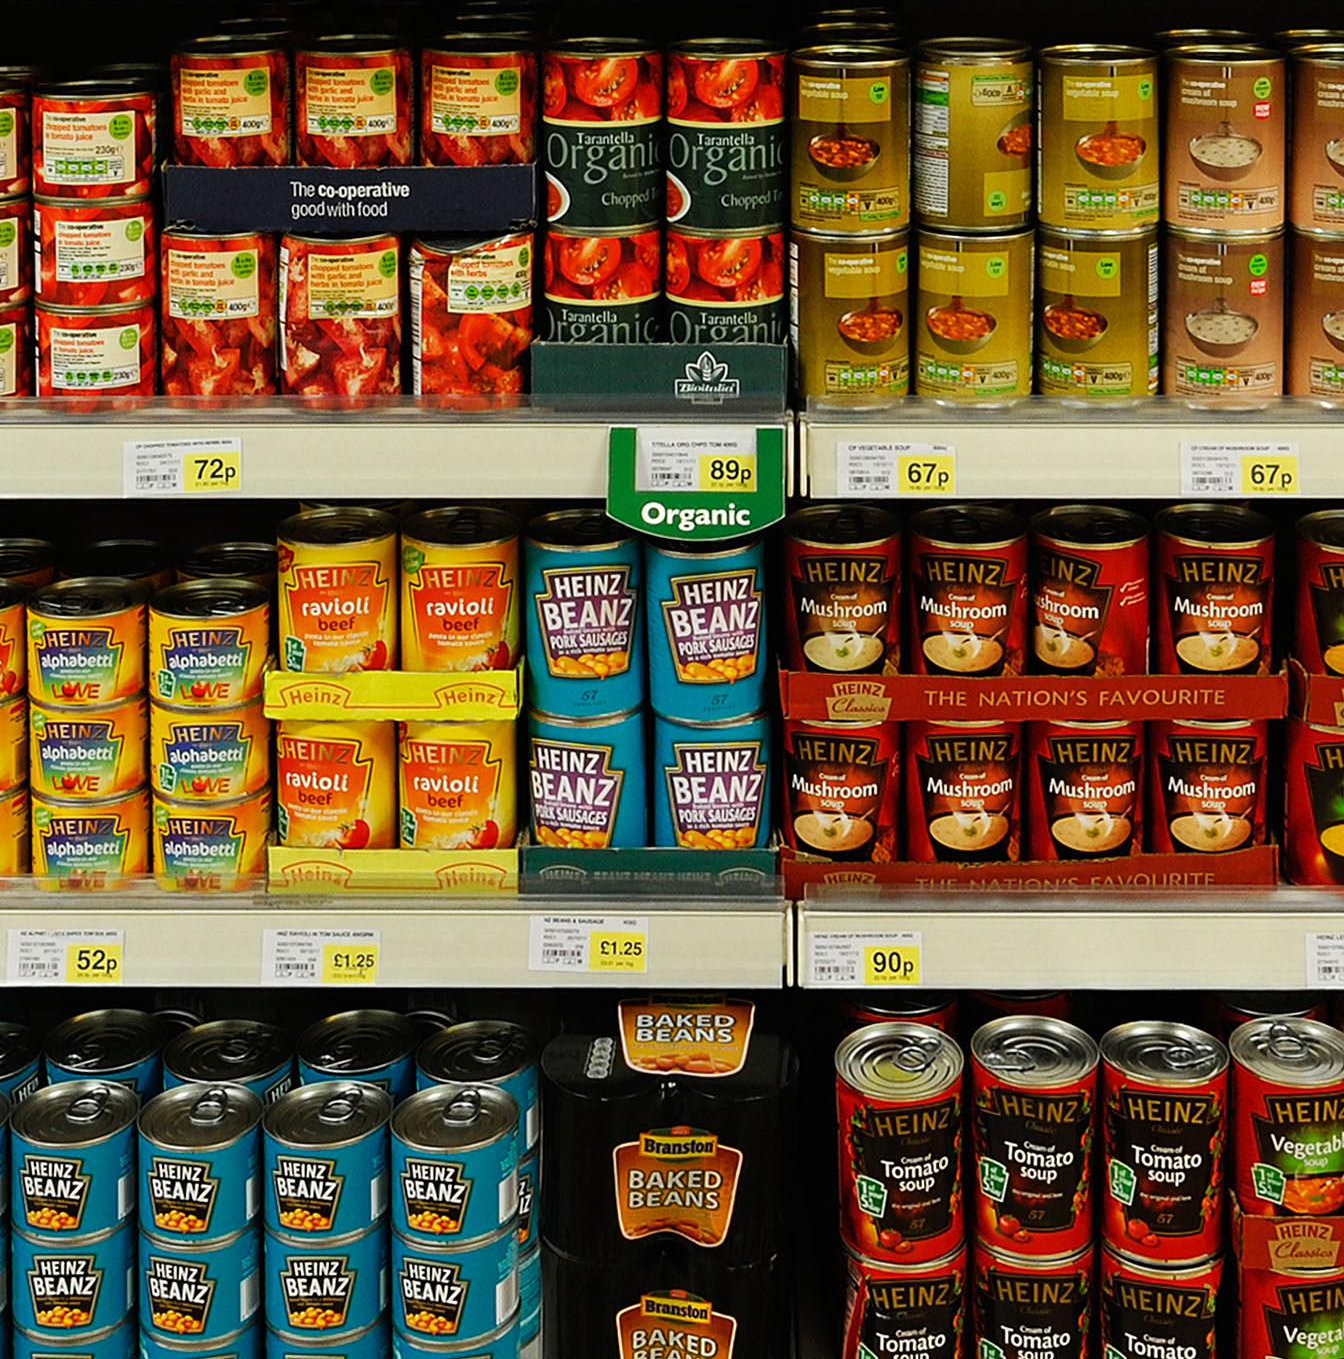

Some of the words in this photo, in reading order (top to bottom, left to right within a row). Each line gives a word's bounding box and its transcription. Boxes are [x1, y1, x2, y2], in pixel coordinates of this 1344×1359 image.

[697, 132, 755, 145] Tarantella
[710, 459, 752, 485] 89p
[640, 502, 750, 531] Organic
[302, 595, 370, 617] ravioli
[543, 598, 634, 629] BEANZ
[800, 596, 887, 619] Mushroom
[41, 652, 113, 669] alphabetti
[925, 689, 967, 707] THE
[979, 689, 1088, 708] NATION'S
[1098, 689, 1226, 707] FAVOURITE
[77, 950, 117, 972] 52p
[334, 951, 374, 969] £1.25
[636, 1014, 734, 1029] BAKED
[635, 1027, 733, 1044] BEANS
[881, 1155, 949, 1180] Tomato
[899, 1175, 935, 1193] soup
